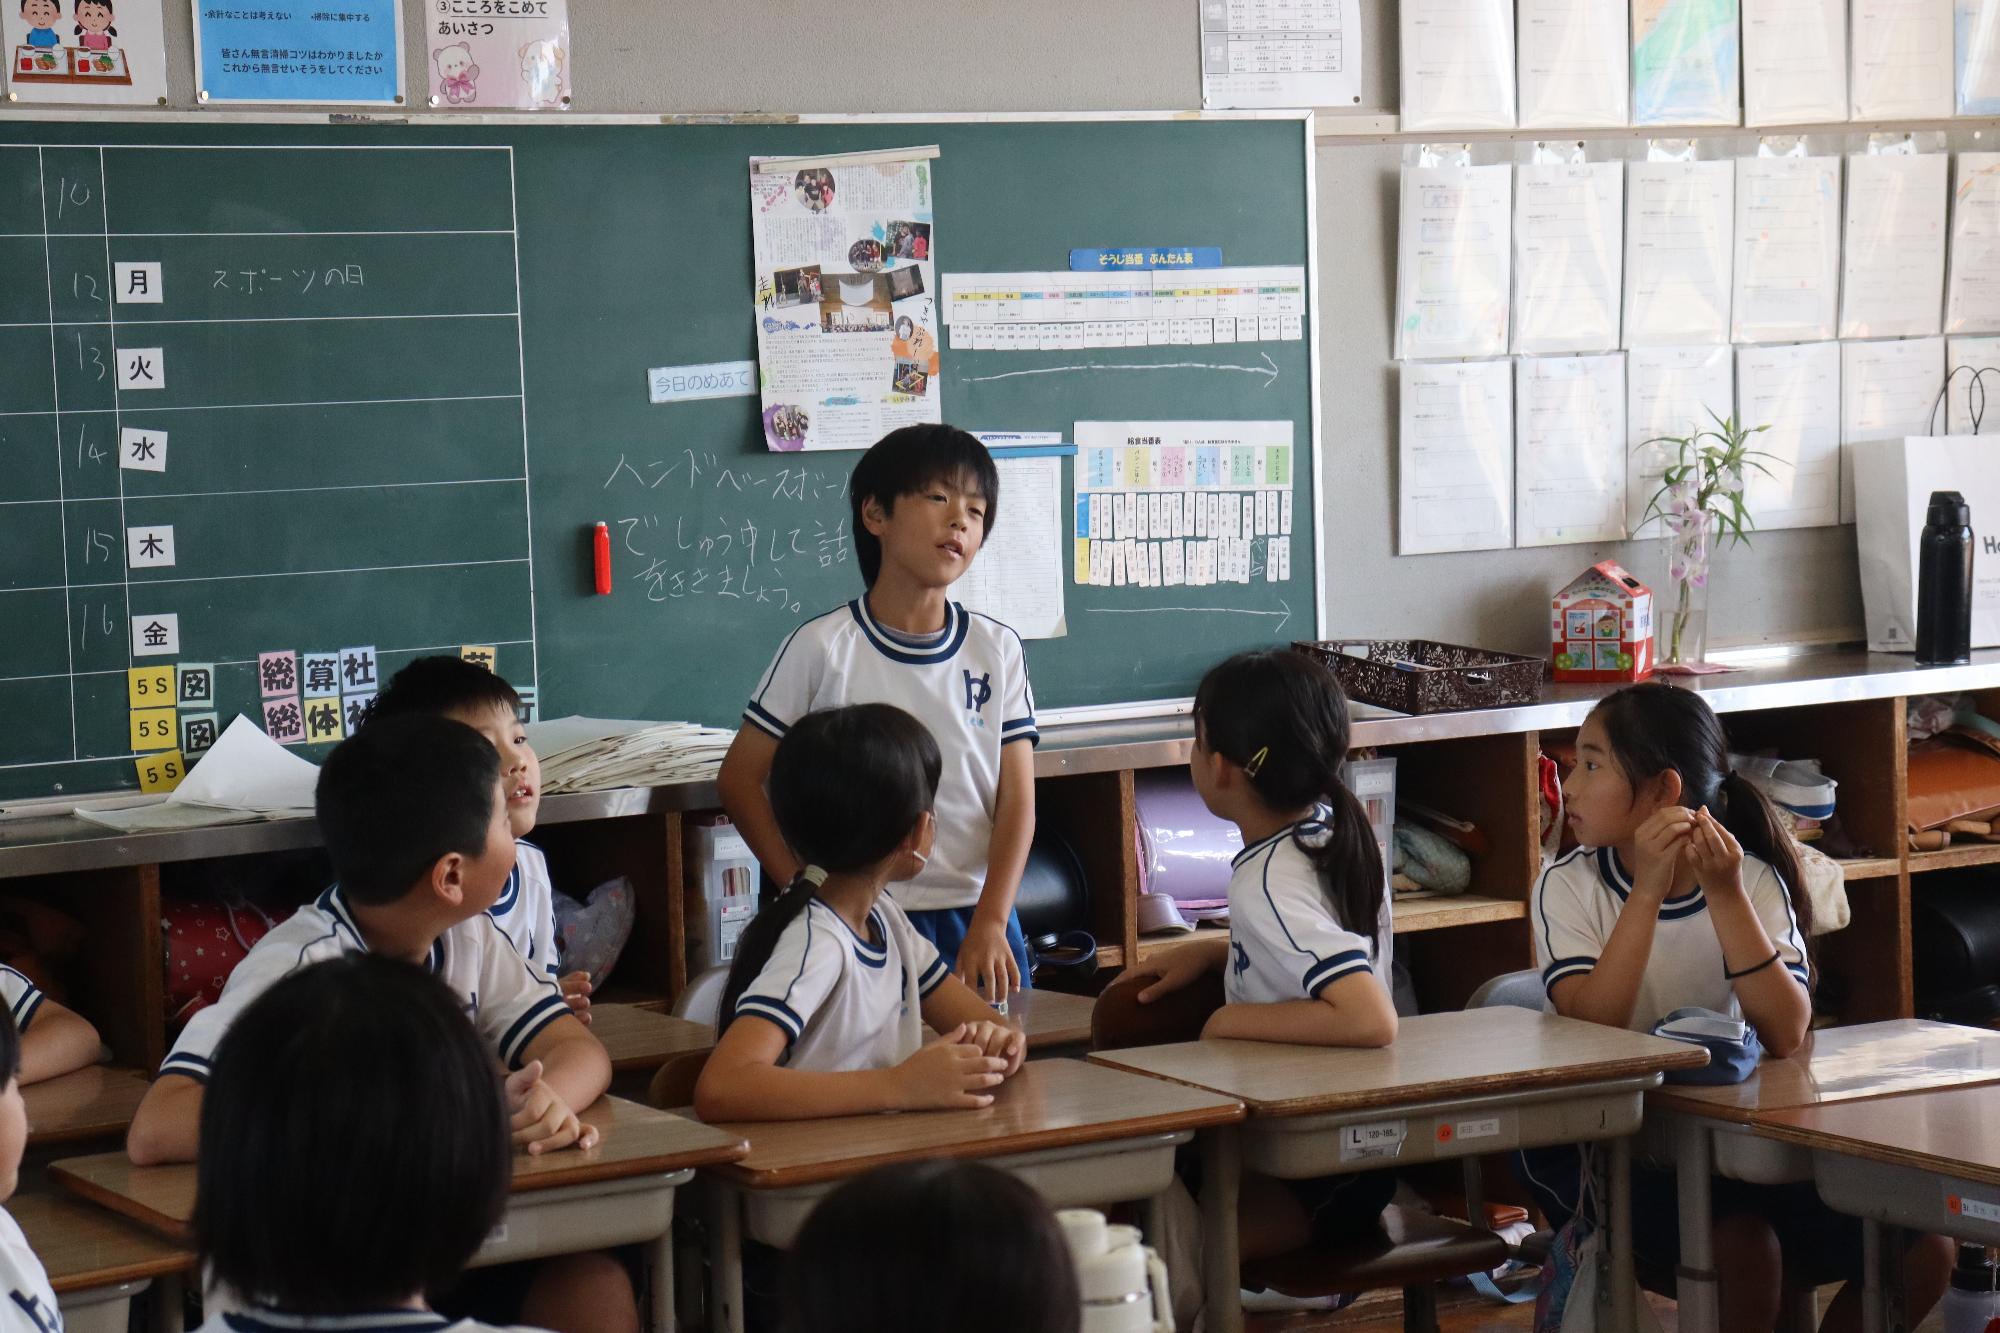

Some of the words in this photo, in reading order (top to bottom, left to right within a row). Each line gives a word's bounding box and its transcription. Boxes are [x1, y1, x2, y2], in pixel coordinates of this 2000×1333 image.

[438, 21, 494, 35] あいさつ
[222, 63, 383, 75] これから無言せいそうをしてください
[58, 177, 90, 219] 10
[1099, 253, 1144, 265] そうじ当番
[1149, 252, 1194, 265] ぶんたん表
[73, 273, 104, 300] 12
[129, 270, 149, 295] 月
[213, 264, 364, 294] スポーツの日
[78, 332, 105, 381] 13
[129, 355, 154, 381] 火
[656, 371, 750, 394] 今日のめあて
[78, 424, 108, 467] 14
[131, 438, 155, 462] 水
[86, 526, 114, 564] 15
[140, 533, 165, 559] 木
[633, 558, 801, 614] をききましょう。
[82, 604, 113, 650] 16
[143, 621, 169, 647] 金
[180, 669, 210, 700] 図
[261, 656, 296, 693] 総
[306, 658, 337, 692] 算
[343, 652, 375, 686] 社
[185, 719, 216, 751] 図
[265, 702, 302, 738] 総
[308, 703, 340, 737] 体
[1353, 1129, 1361, 1144] L
